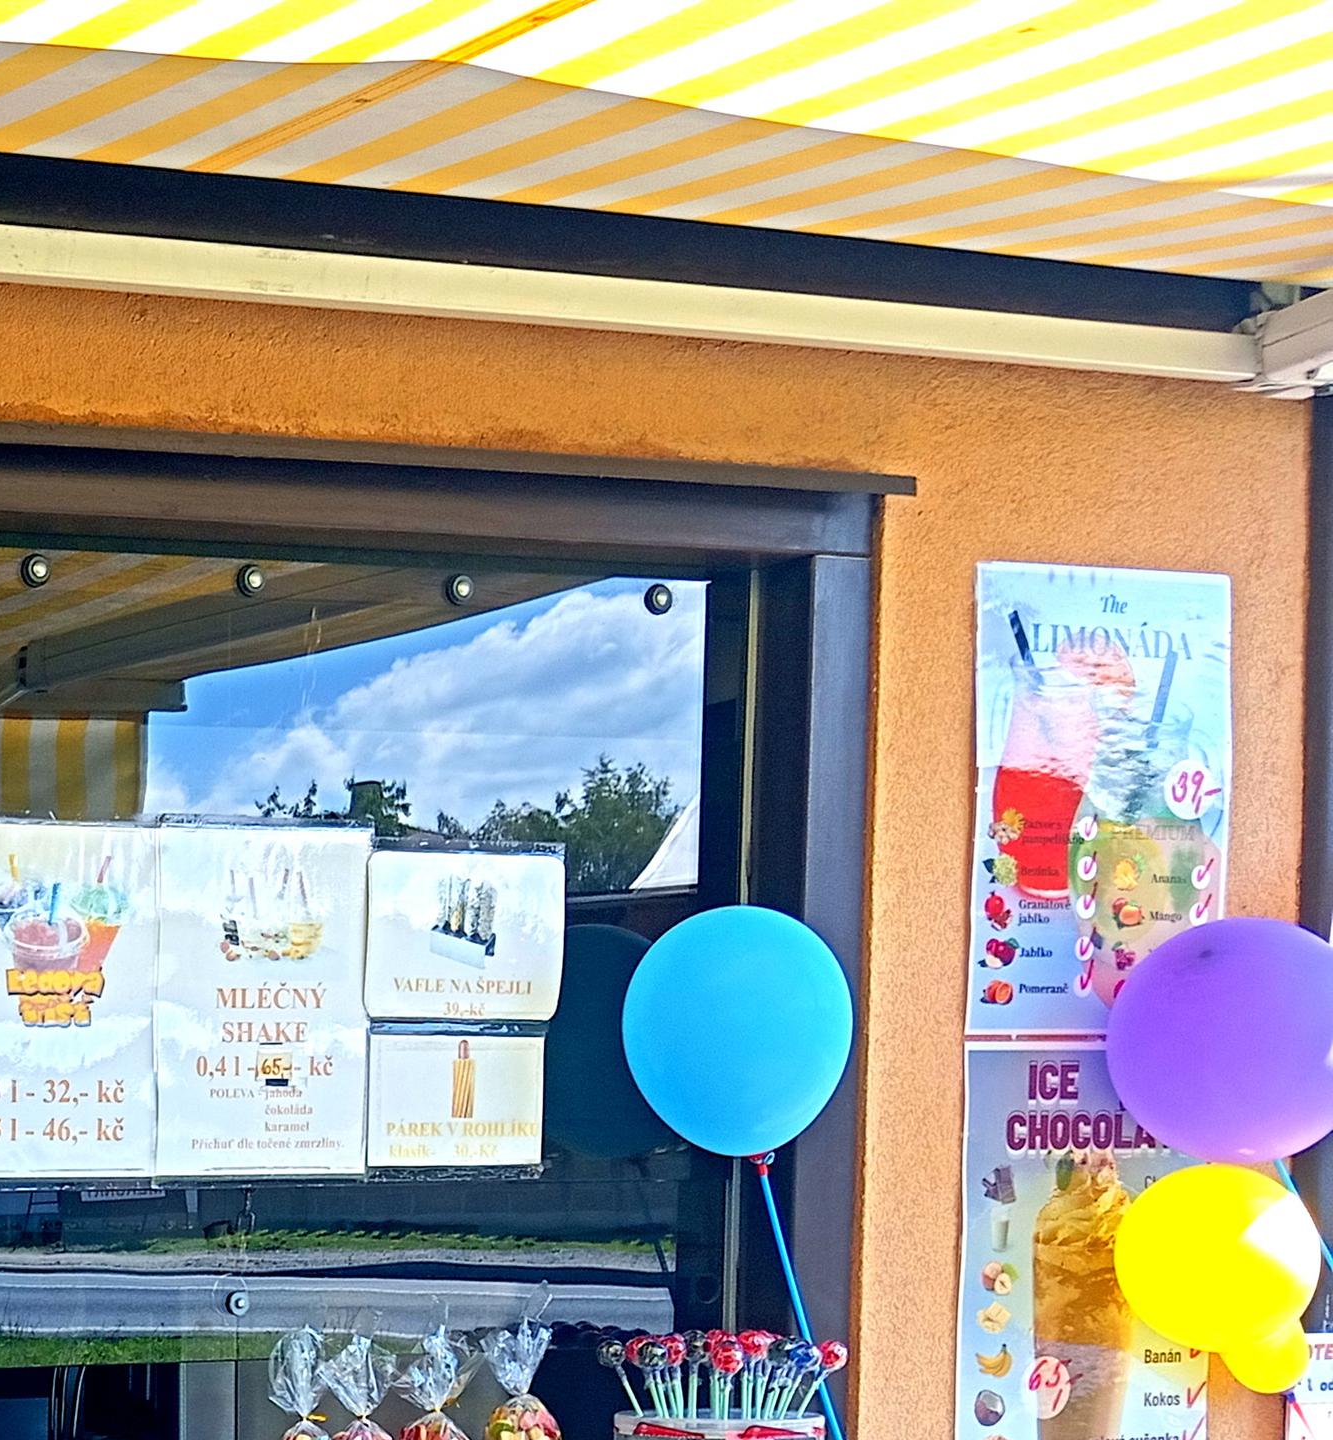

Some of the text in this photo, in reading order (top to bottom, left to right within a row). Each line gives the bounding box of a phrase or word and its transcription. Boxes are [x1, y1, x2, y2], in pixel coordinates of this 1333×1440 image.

[1100, 594, 1128, 614] The
[1031, 622, 1192, 660] LIMONÁDA
[1149, 911, 1183, 923] Mango
[394, 976, 533, 995] VAFLE NA ŠPEJLI
[1018, 982, 1070, 994] Pomeranč
[216, 982, 327, 1009] MLÉČNÝ
[222, 1022, 308, 1042] SHAKE
[196, 1055, 226, 1081] 0,4
[309, 1055, 333, 1076] kč
[1028, 1063, 1080, 1101] ICE
[43, 1079, 89, 1108] 32,-
[97, 1079, 125, 1103] kč
[210, 1088, 254, 1098] POLEVA
[265, 1104, 313, 1115] čokoláda
[42, 1117, 88, 1146] 46,-
[97, 1117, 124, 1141] kč
[265, 1121, 310, 1132] karamel
[387, 1119, 443, 1137] PÁREK
[1006, 1112, 1171, 1151] CHOCOLA
[237, 1138, 254, 1149] dle
[257, 1138, 292, 1149] točené
[1144, 1348, 1181, 1363] Banán
[1144, 1392, 1181, 1407] Kokos
